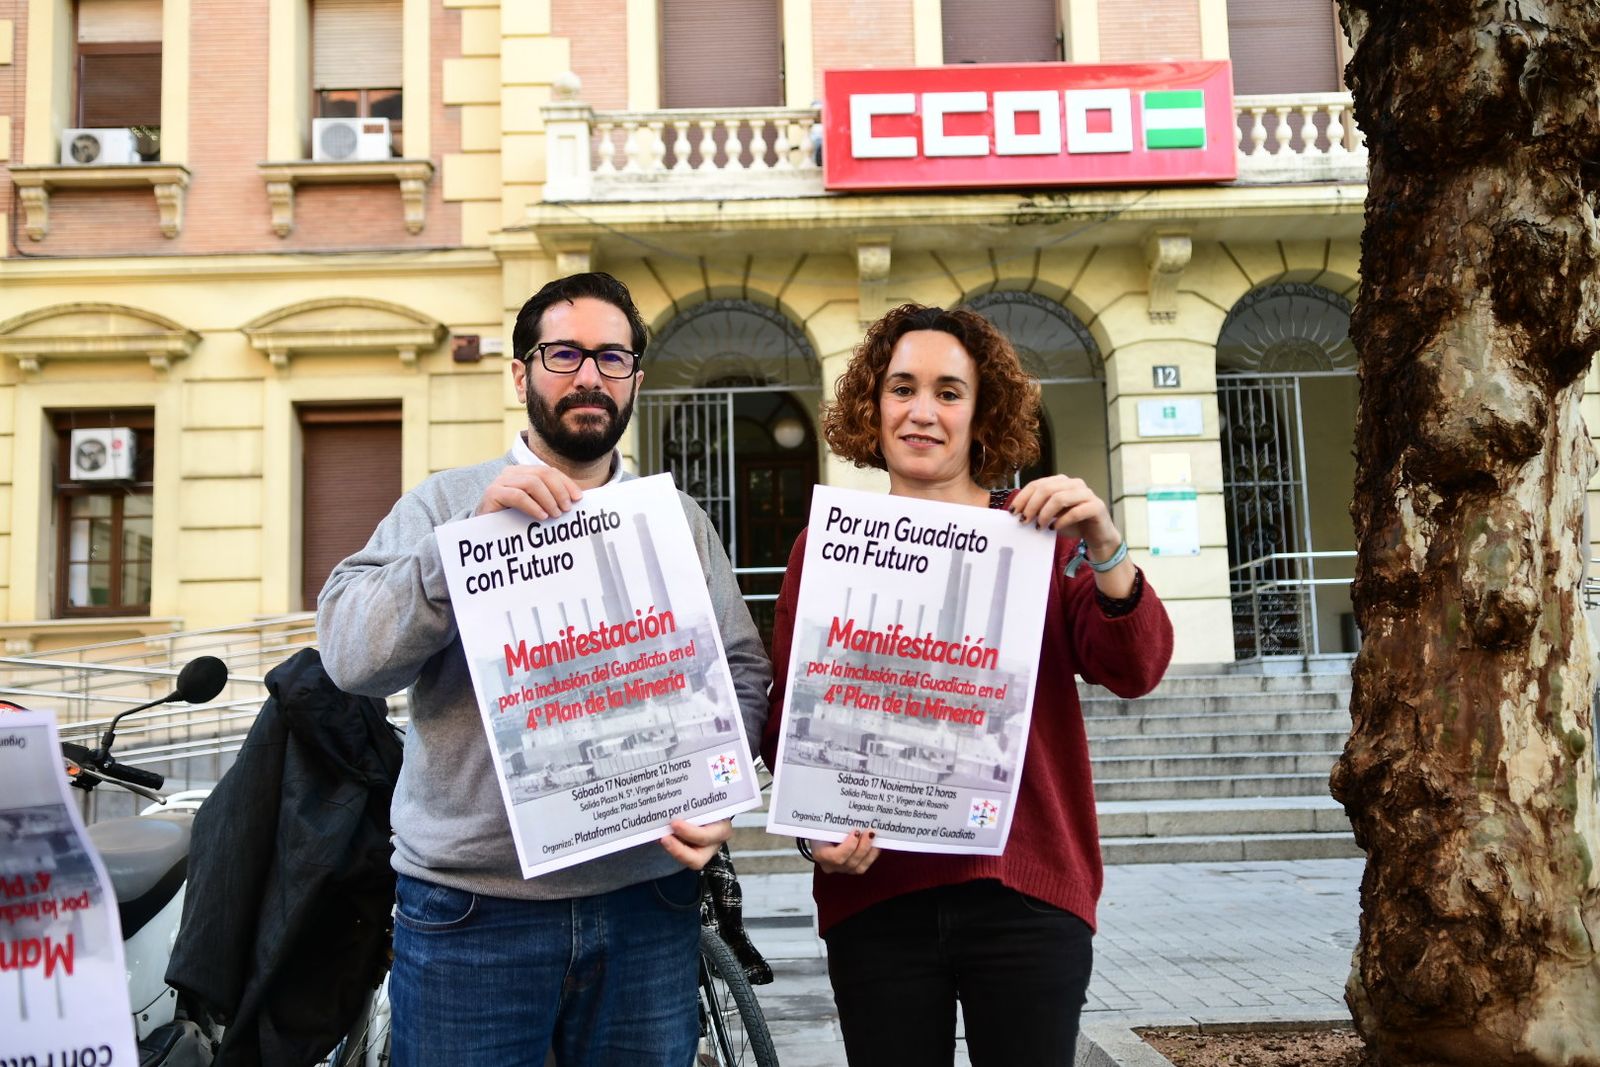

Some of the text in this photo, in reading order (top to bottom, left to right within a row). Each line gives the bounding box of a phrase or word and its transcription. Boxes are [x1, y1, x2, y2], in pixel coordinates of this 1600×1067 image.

[850, 89, 1133, 158] CCOO
[1157, 368, 1177, 386] 12
[459, 508, 620, 567] Por un Guadiato
[826, 506, 988, 553] Por un Guadiato
[466, 551, 574, 594] con Futuro
[822, 540, 929, 573] con Futuro
[504, 606, 676, 677] Manifestación
[827, 616, 999, 670] Manifestación
[499, 640, 695, 713] por la inclusión del Guadiato en el
[807, 660, 1008, 700] por la inclusión del Guadiato en el
[544, 700, 584, 726] Plan
[585, 692, 606, 714] de
[606, 685, 624, 708] la
[624, 669, 686, 705] Minería
[842, 685, 881, 711] Plan
[883, 690, 904, 714] de
[904, 694, 921, 717] la
[922, 698, 985, 726] Minería
[572, 782, 604, 801] Sábado
[605, 780, 613, 794] 17
[659, 764, 668, 775] 12
[668, 758, 691, 774] horas
[580, 799, 600, 812] Salida
[600, 794, 618, 807] Plaza
[618, 791, 626, 802] N.
[635, 784, 656, 797] Virgen
[657, 779, 666, 790] del
[666, 774, 688, 788] Rosario
[837, 773, 869, 787] Sábado
[871, 778, 878, 789] 17
[926, 785, 933, 796] 12
[933, 785, 957, 800] horas
[840, 788, 860, 798] Salida
[861, 790, 878, 800] Plaza
[878, 792, 885, 801] N.
[896, 795, 915, 807] Virgen
[916, 798, 926, 808] del
[926, 799, 949, 810] Rosario
[620, 802, 637, 813] Plaza
[638, 796, 657, 808] Santa
[656, 788, 682, 804] Bárbara
[876, 805, 893, 815] Plaza
[894, 808, 912, 817] Santa
[912, 809, 937, 820] Bárbara
[542, 790, 727, 854] Organiza: Plataforma Ciudadana por el Guadiato
[792, 810, 975, 840] Organiza: Plataforma Ciudadana por el Guadiato
[42, 897, 58, 921] la
[60, 890, 88, 912] por
[0, 933, 74, 980] Man
